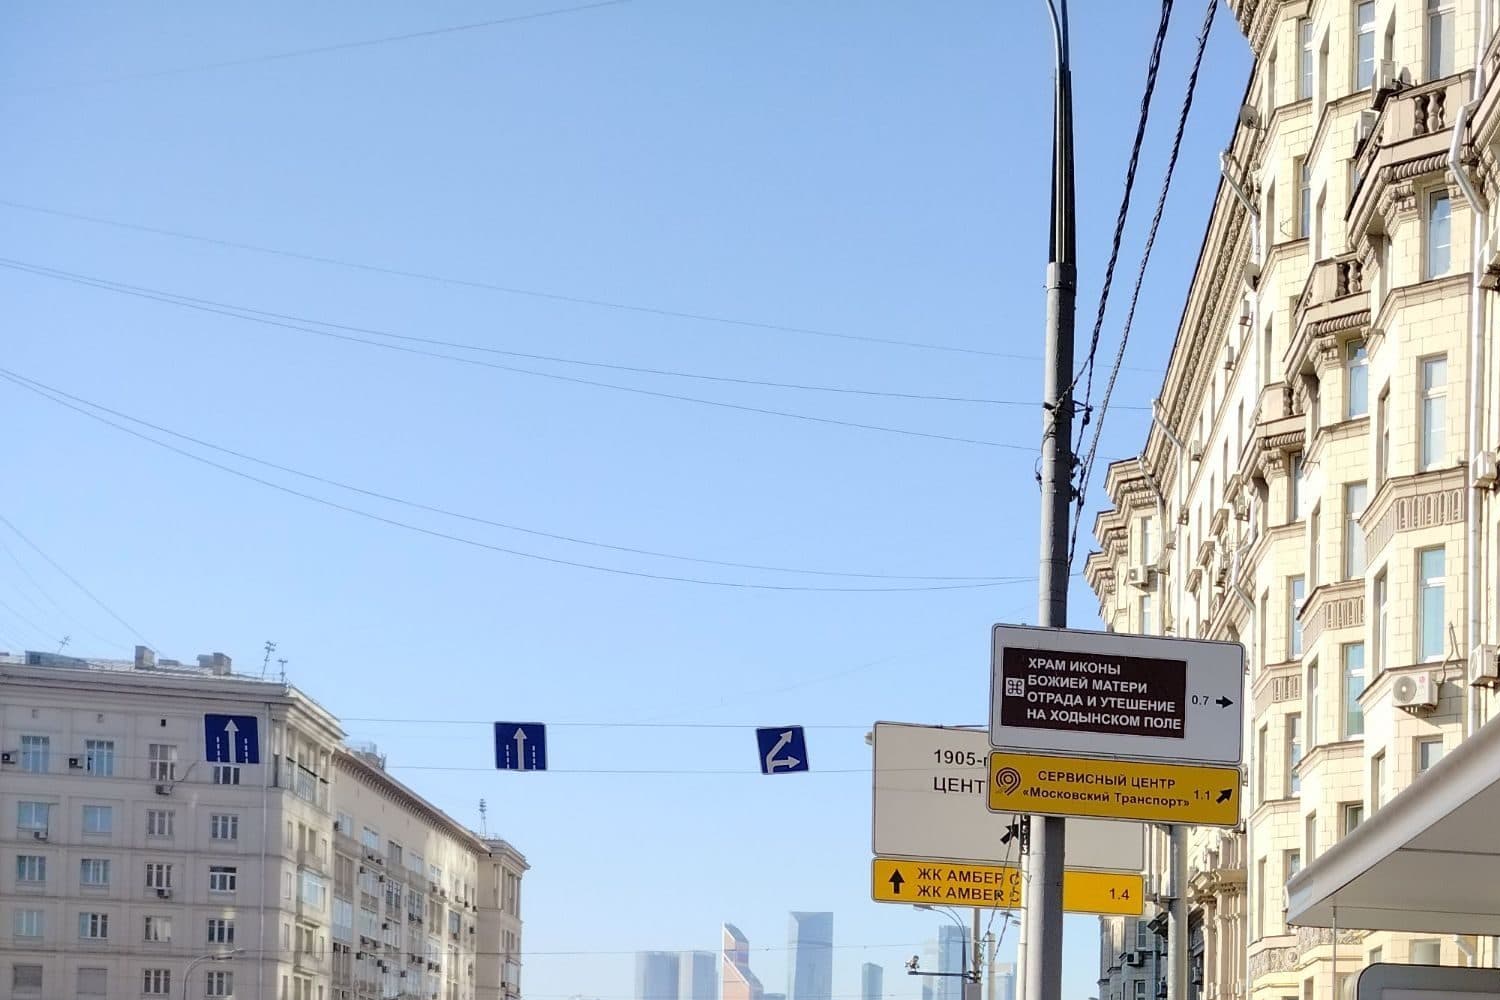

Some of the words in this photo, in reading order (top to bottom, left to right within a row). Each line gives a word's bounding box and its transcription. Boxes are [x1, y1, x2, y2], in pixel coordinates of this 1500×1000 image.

[1028, 657, 1065, 671] ХРАМ
[1070, 660, 1121, 675] ИКОНЫ
[1027, 674, 1089, 690] БОЖИЕЙ
[1092, 679, 1148, 694] МАТЕРИ
[1027, 691, 1083, 707] ОТРАДА
[1087, 695, 1097, 706] И
[1100, 698, 1176, 713] УТЕШЕНИЕ
[1191, 695, 1209, 705] 0.7
[1027, 709, 1047, 720] НА
[1049, 710, 1141, 727] ХОДЫНСКОМ
[1144, 716, 1182, 730] ПОЛЕ
[1037, 770, 1127, 787] СЕРВИСНЫЙ
[1131, 777, 1176, 790] ЦЕНТР
[1022, 787, 1110, 802] «Московский
[1114, 792, 1190, 809] Транспорт»
[1193, 789, 1210, 800] 1.1
[917, 867, 942, 881] ЖК
[947, 869, 1004, 885] АМБЕР
[917, 884, 942, 897] ЖК
[1109, 888, 1130, 901] 1.4
